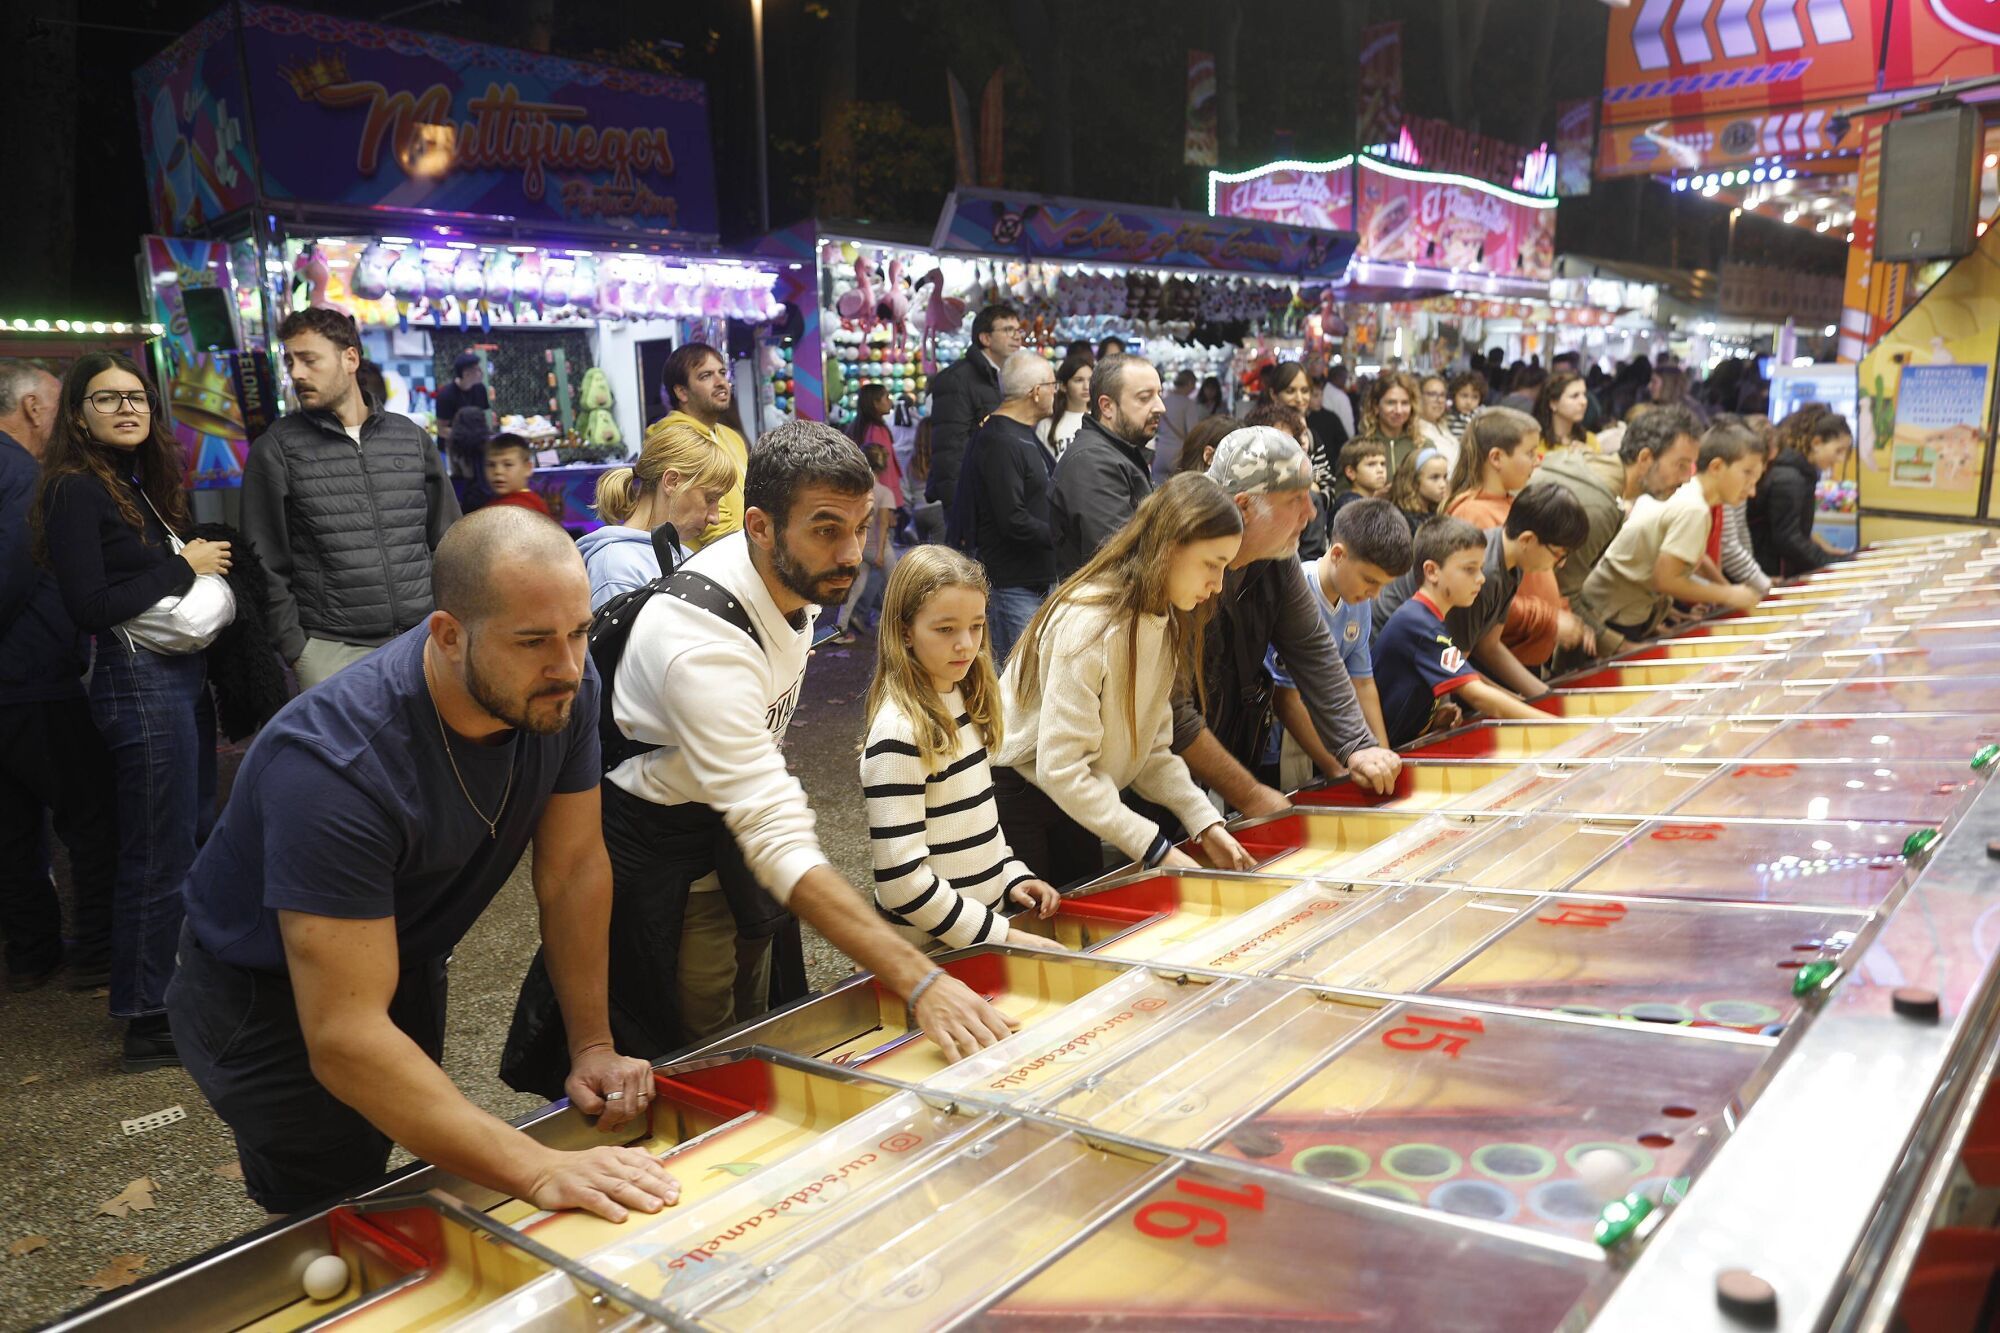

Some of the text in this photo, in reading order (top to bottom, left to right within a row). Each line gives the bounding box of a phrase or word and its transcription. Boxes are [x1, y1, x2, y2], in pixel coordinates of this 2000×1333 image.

[1537, 902, 1627, 928] 14
[990, 1011, 1134, 1090] cursadecamells
[1382, 1016, 1486, 1058] 15
[667, 1152, 878, 1271] cursadecamells
[1133, 1179, 1266, 1248] 16
